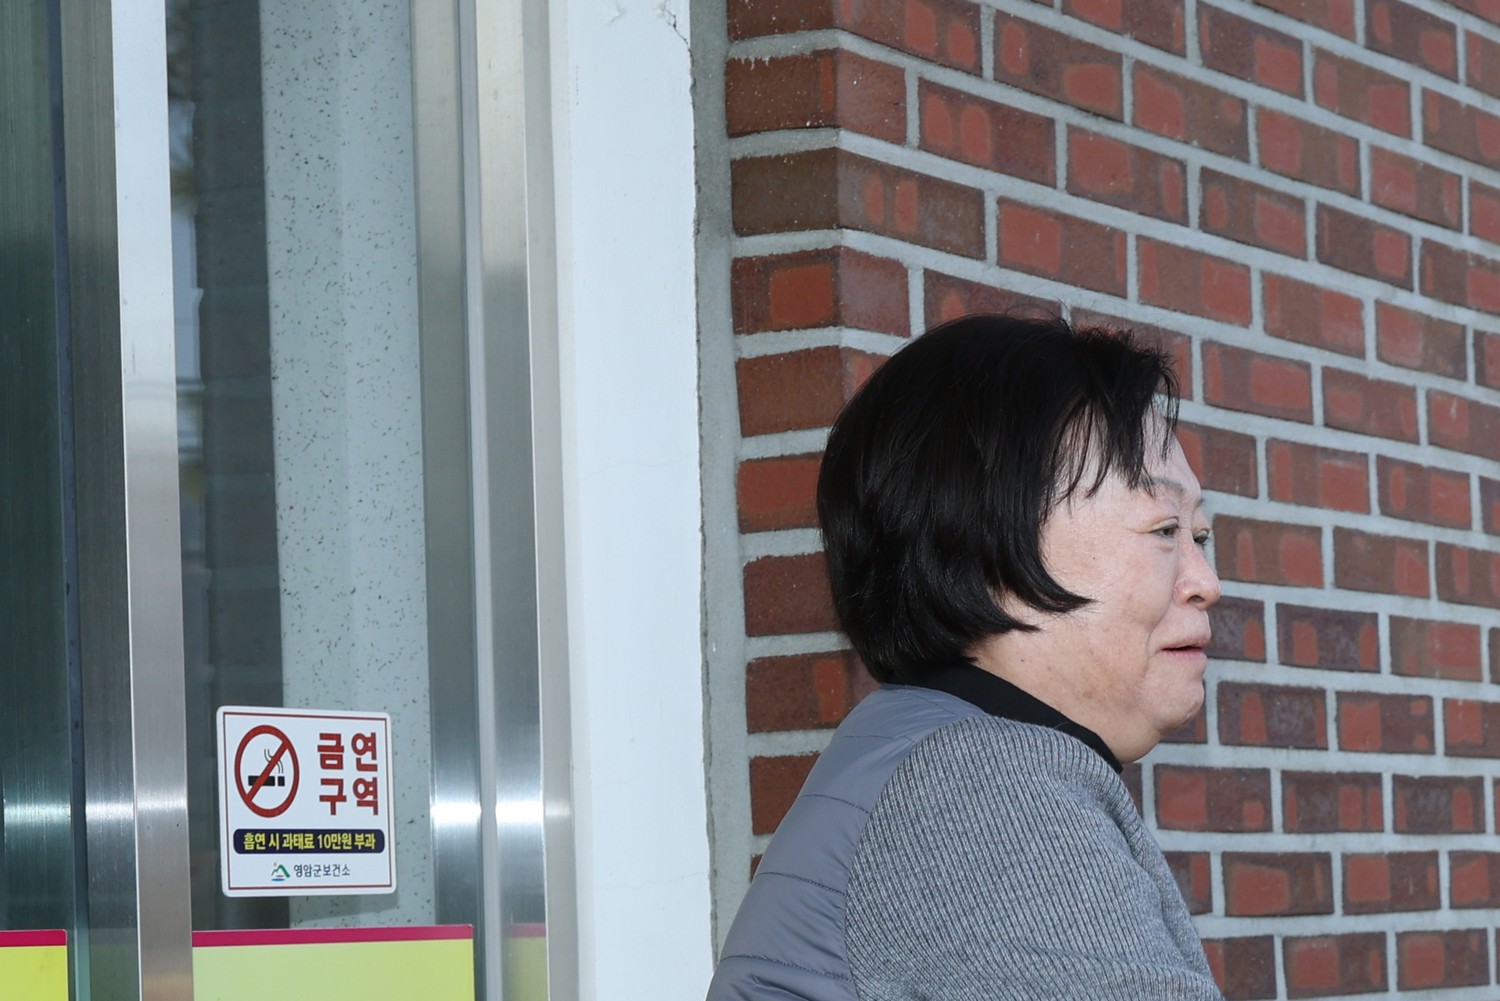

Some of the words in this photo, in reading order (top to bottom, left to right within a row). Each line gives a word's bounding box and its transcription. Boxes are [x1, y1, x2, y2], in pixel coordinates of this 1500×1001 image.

[317, 732, 378, 772] 금연
[319, 776, 379, 816] 구역
[268, 833, 280, 850] 시
[282, 832, 315, 850] 과태료
[317, 832, 352, 850] 10만원
[354, 832, 376, 850] 부과
[293, 863, 351, 878] 영암군보건소
